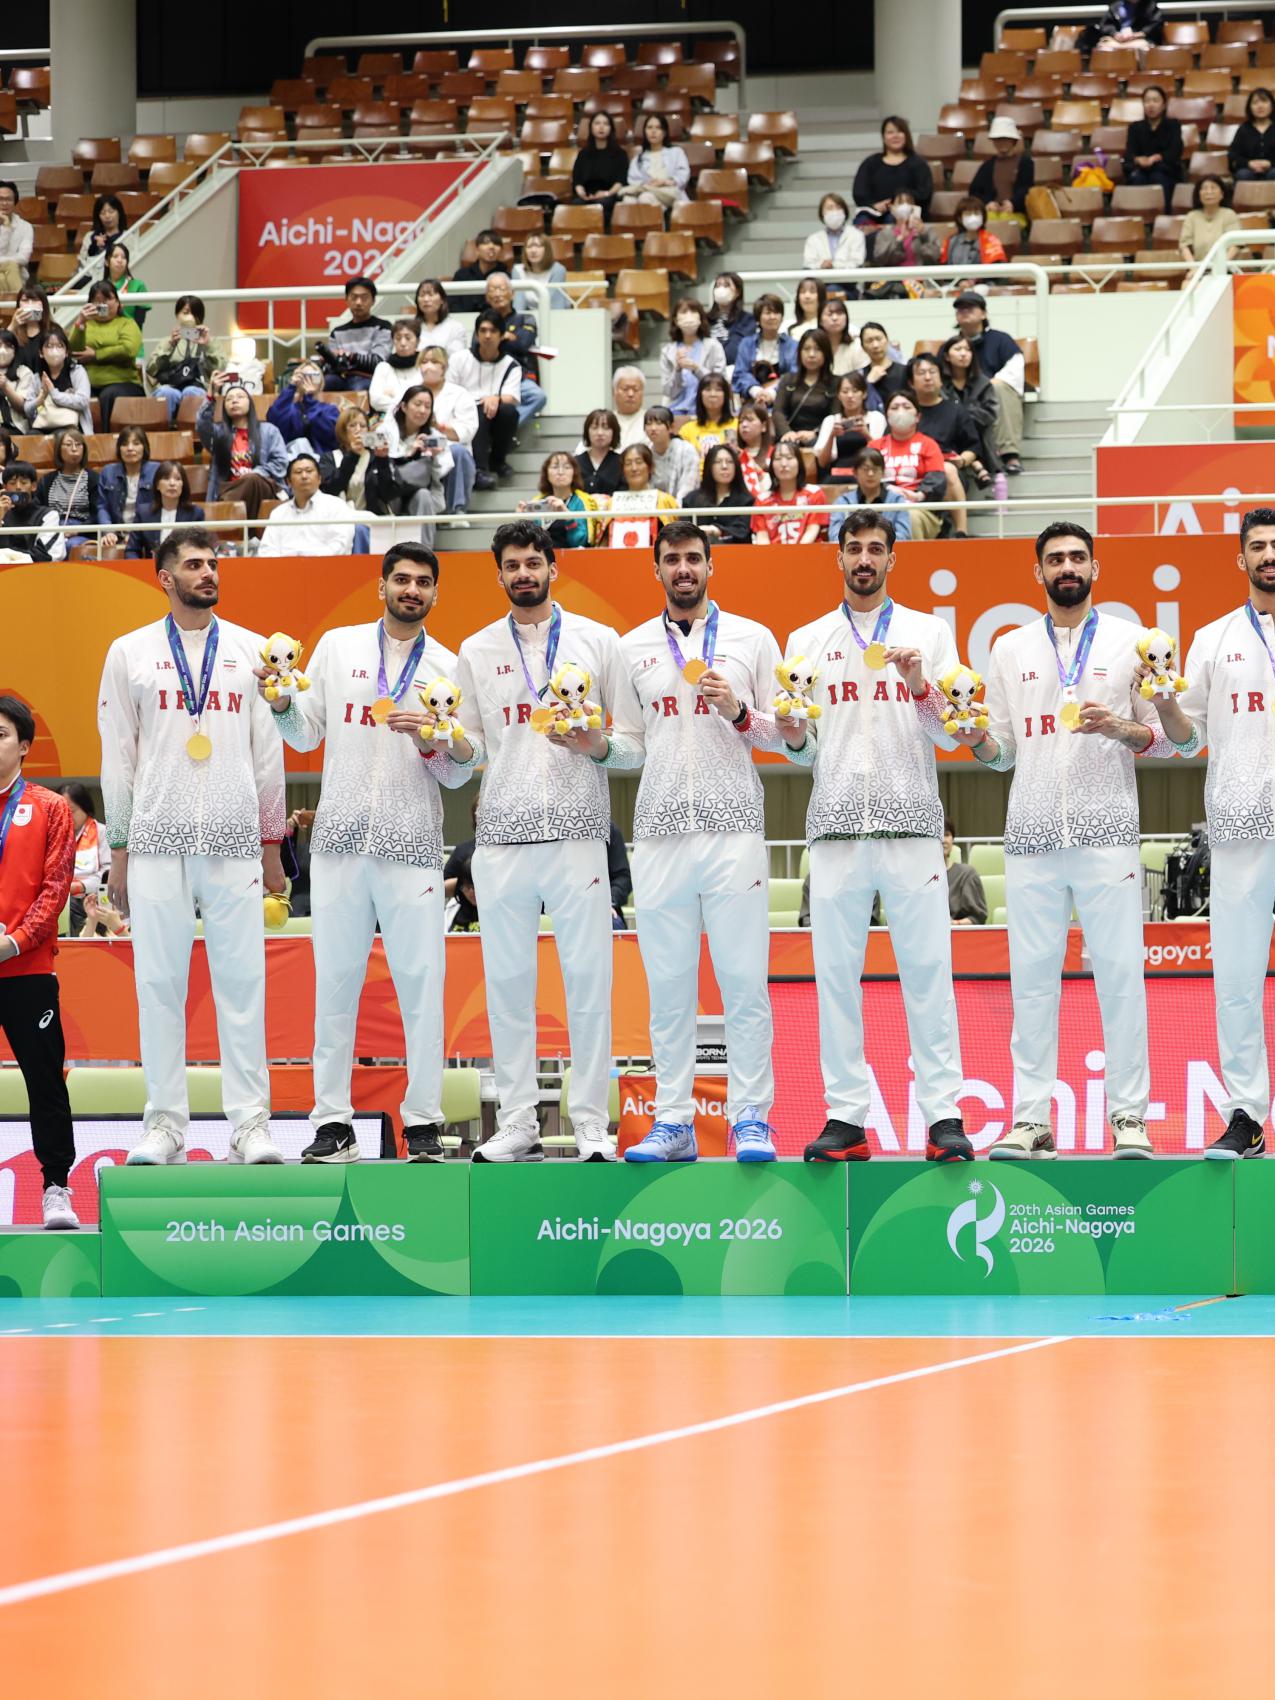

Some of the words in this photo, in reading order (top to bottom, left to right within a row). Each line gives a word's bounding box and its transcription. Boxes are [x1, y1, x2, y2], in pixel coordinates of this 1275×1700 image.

[323, 249, 389, 276] 202
[777, 522, 802, 545] 15
[156, 661, 175, 671] I.R.
[643, 657, 660, 669] I.R.
[826, 651, 845, 662] I.R.
[1226, 652, 1246, 663] I.R.
[352, 669, 370, 680] I.R.
[496, 664, 515, 676] I.R.
[1022, 670, 1040, 683] I.R.
[158, 689, 244, 714] IRAN
[827, 680, 914, 706] IRAN
[651, 694, 711, 718] RA
[1024, 714, 1056, 739] IR
[1009, 1204, 1041, 1216] 20th
[1044, 1204, 1082, 1216] Asian
[1086, 1203, 1135, 1217] Games
[166, 1219, 226, 1243] 20th
[233, 1219, 305, 1242] Asian
[312, 1219, 406, 1242] Games
[537, 1218, 712, 1247] Aichi-Nagoya
[718, 1218, 783, 1241] 2026
[1010, 1217, 1136, 1239] Aichi-Nagoya
[1009, 1237, 1055, 1253] 2026
